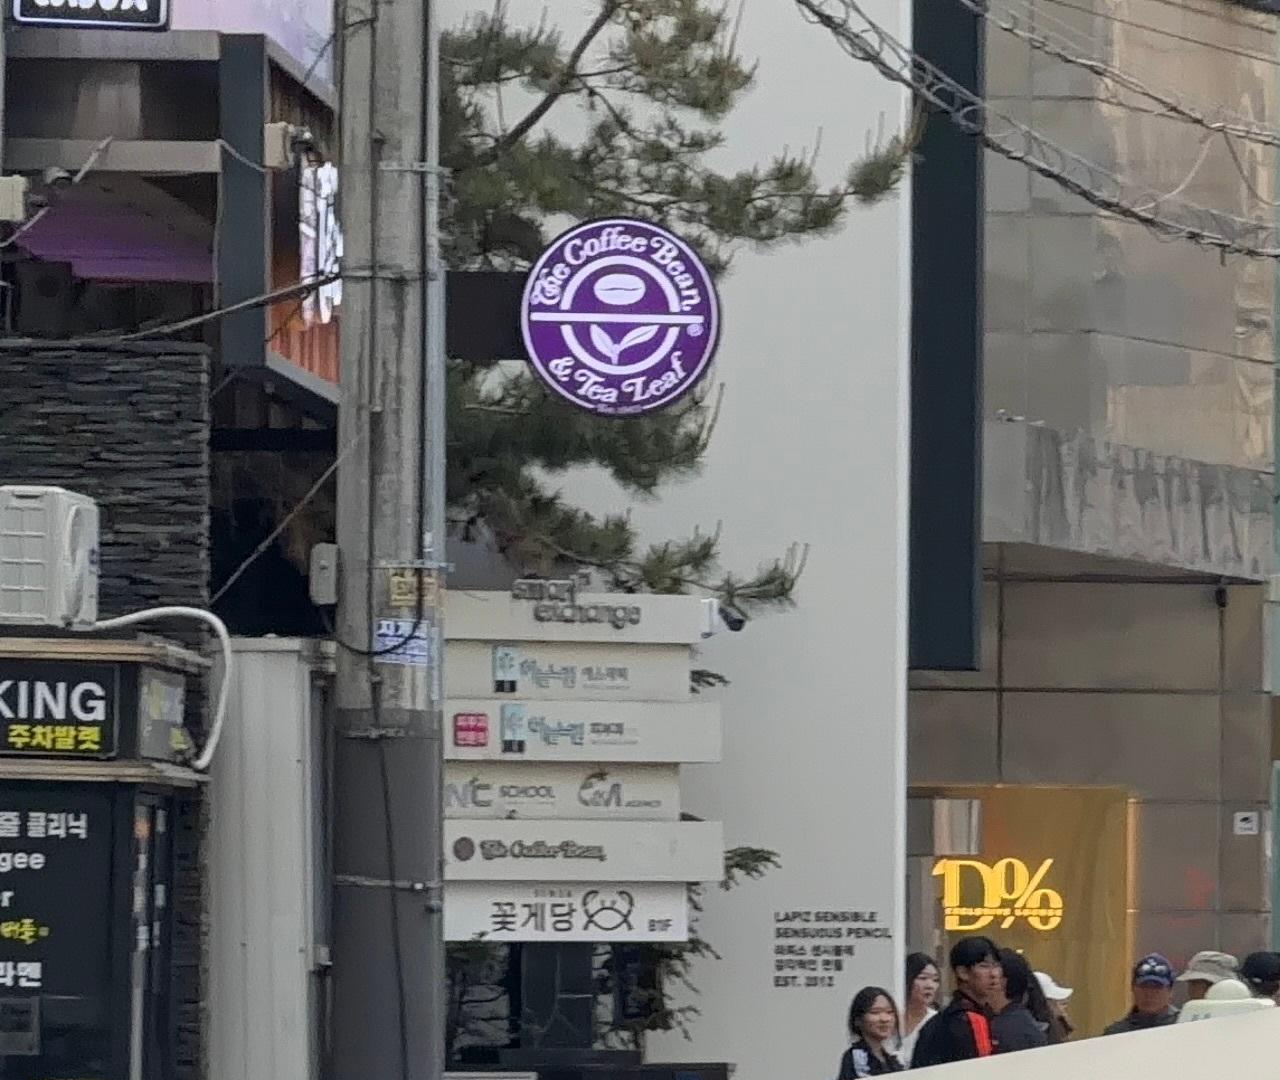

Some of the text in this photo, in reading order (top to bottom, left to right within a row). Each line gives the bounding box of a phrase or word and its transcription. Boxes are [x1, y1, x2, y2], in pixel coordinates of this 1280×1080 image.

[530, 226, 702, 311] The Coffee Bean
[549, 351, 688, 403] & Tea Leaf
[8, 724, 101, 750] 주차발렛
[501, 785, 556, 798] SCHOOL
[27, 812, 88, 839] 클리닉
[490, 902, 577, 932] 꽃게당
[814, 911, 878, 922] SENSIBLE
[846, 927, 892, 938] PENCIL
